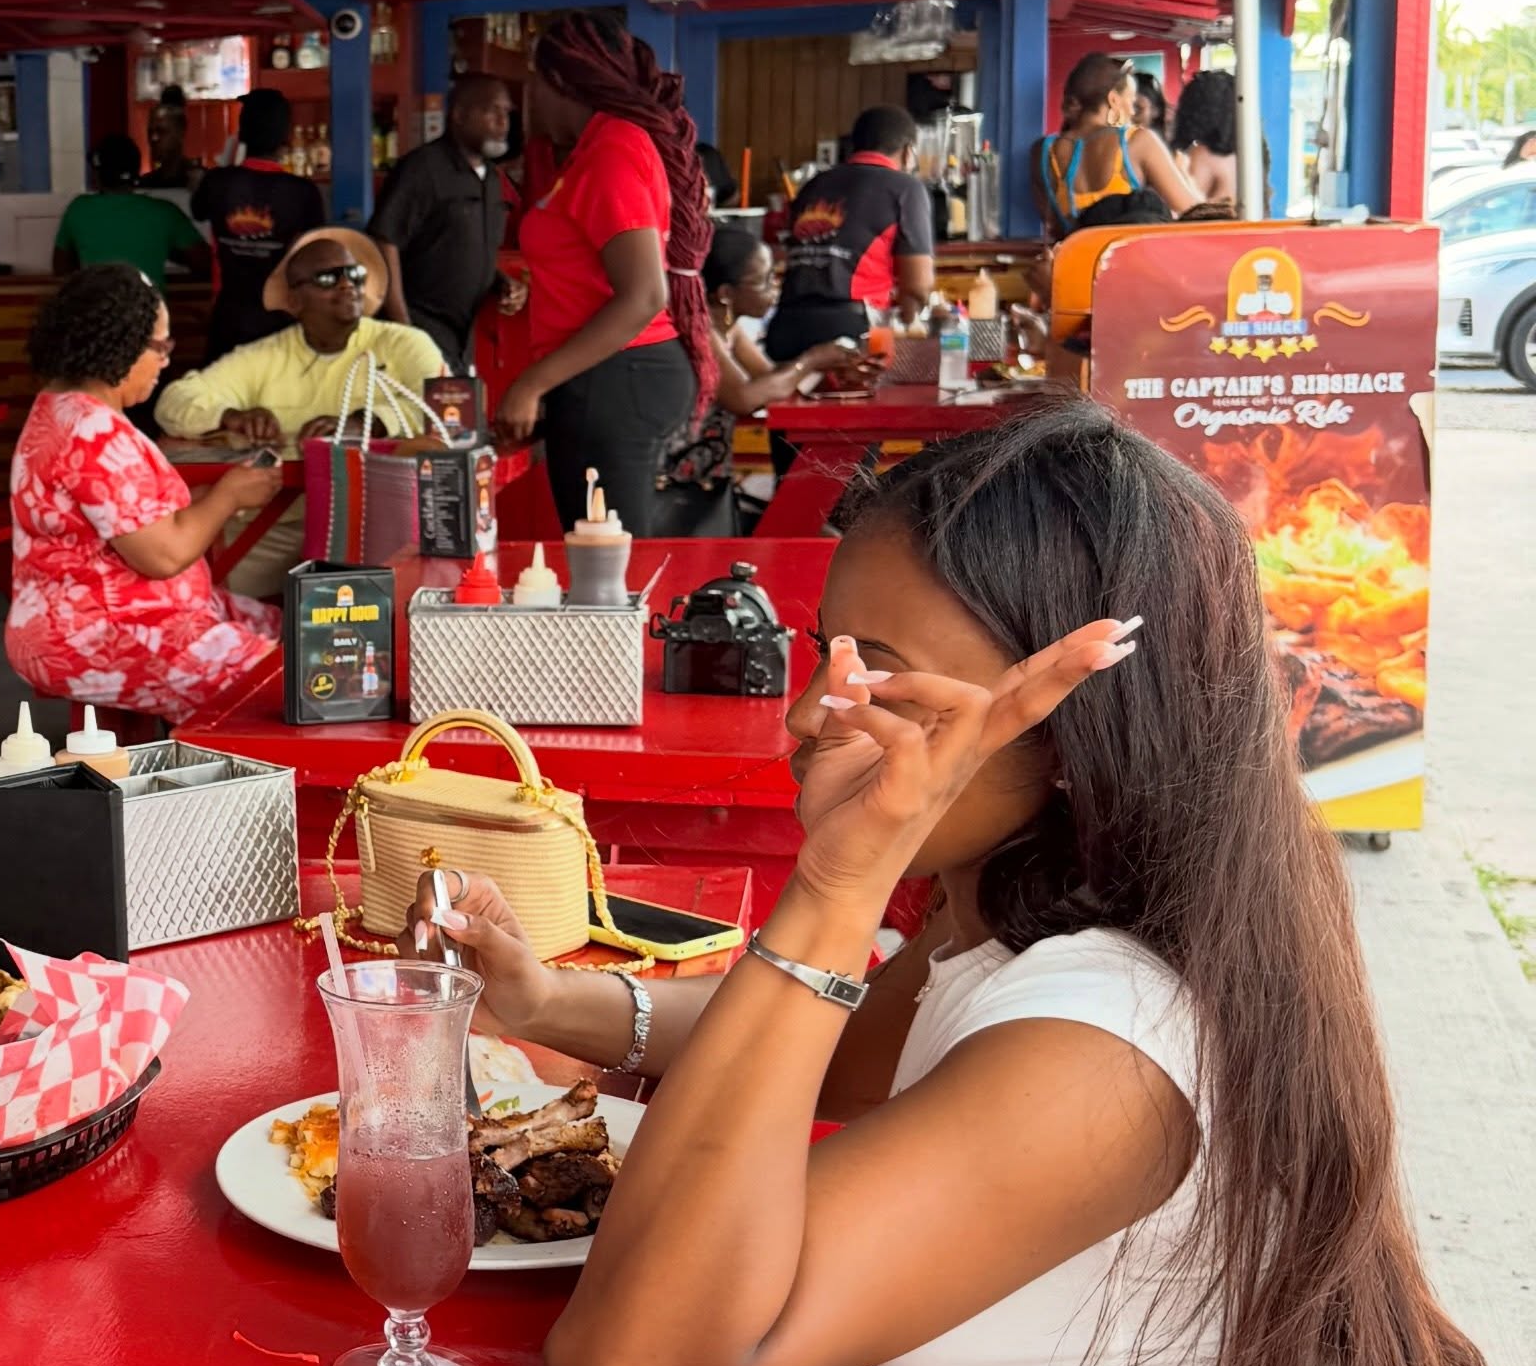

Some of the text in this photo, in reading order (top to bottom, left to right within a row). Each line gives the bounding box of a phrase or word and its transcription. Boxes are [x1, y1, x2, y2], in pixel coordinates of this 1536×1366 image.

[1253, 320, 1304, 334] SHACK
[1124, 372, 1405, 399] THE CAPTAIN'S RIBSHACK
[1212, 395, 1296, 407] HOME OF THE
[1174, 399, 1354, 436] Orgasmic Ribs
[311, 605, 380, 624] HAPPY HOUR
